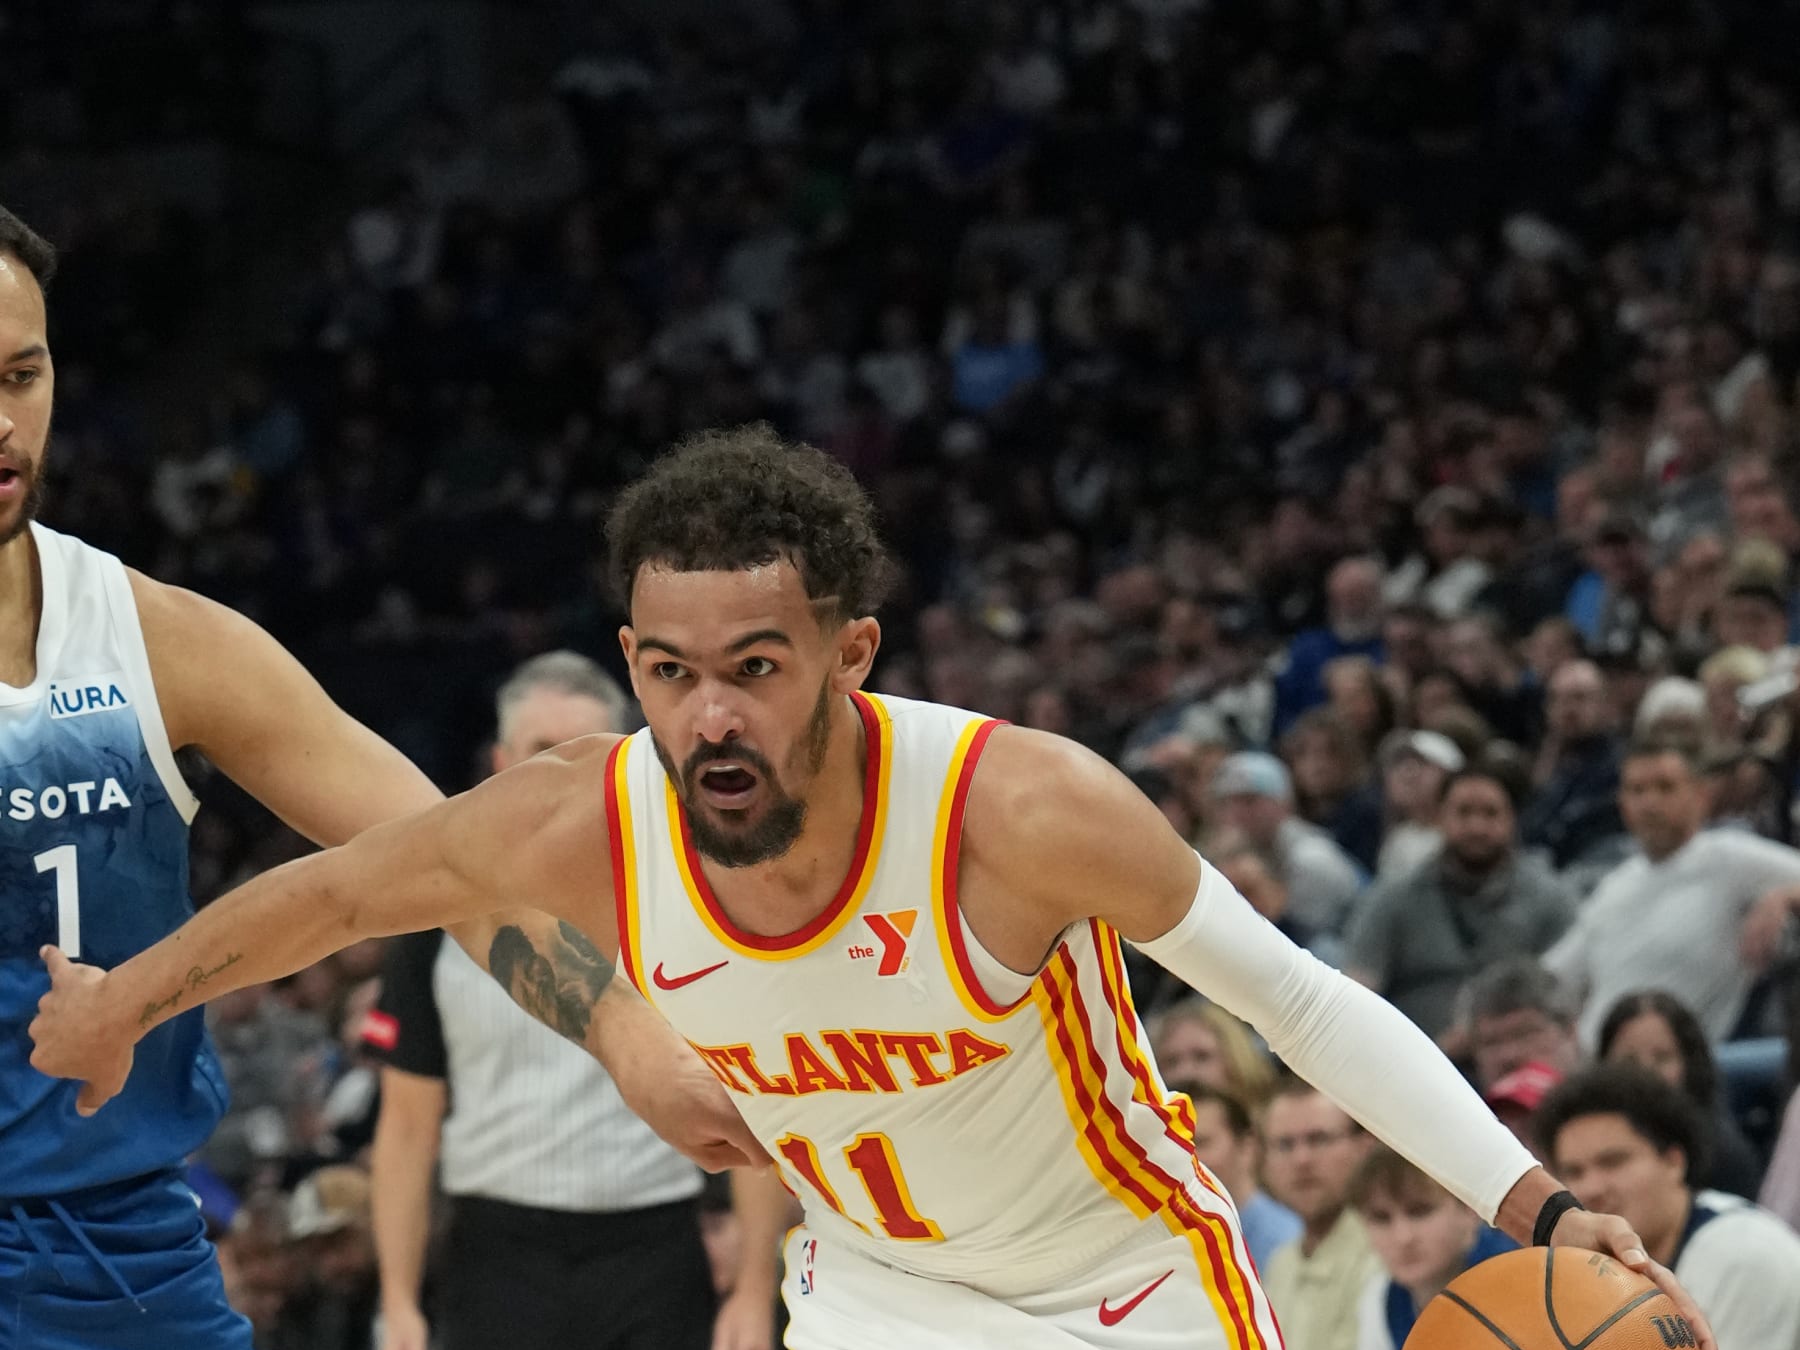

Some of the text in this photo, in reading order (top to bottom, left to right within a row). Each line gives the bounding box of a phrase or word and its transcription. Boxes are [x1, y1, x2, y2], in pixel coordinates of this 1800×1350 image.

[0, 777, 131, 821] SOTA
[33, 845, 80, 958] 1
[848, 945, 874, 959] the
[688, 1028, 1012, 1096] TLANTA
[775, 1131, 946, 1241] 11
